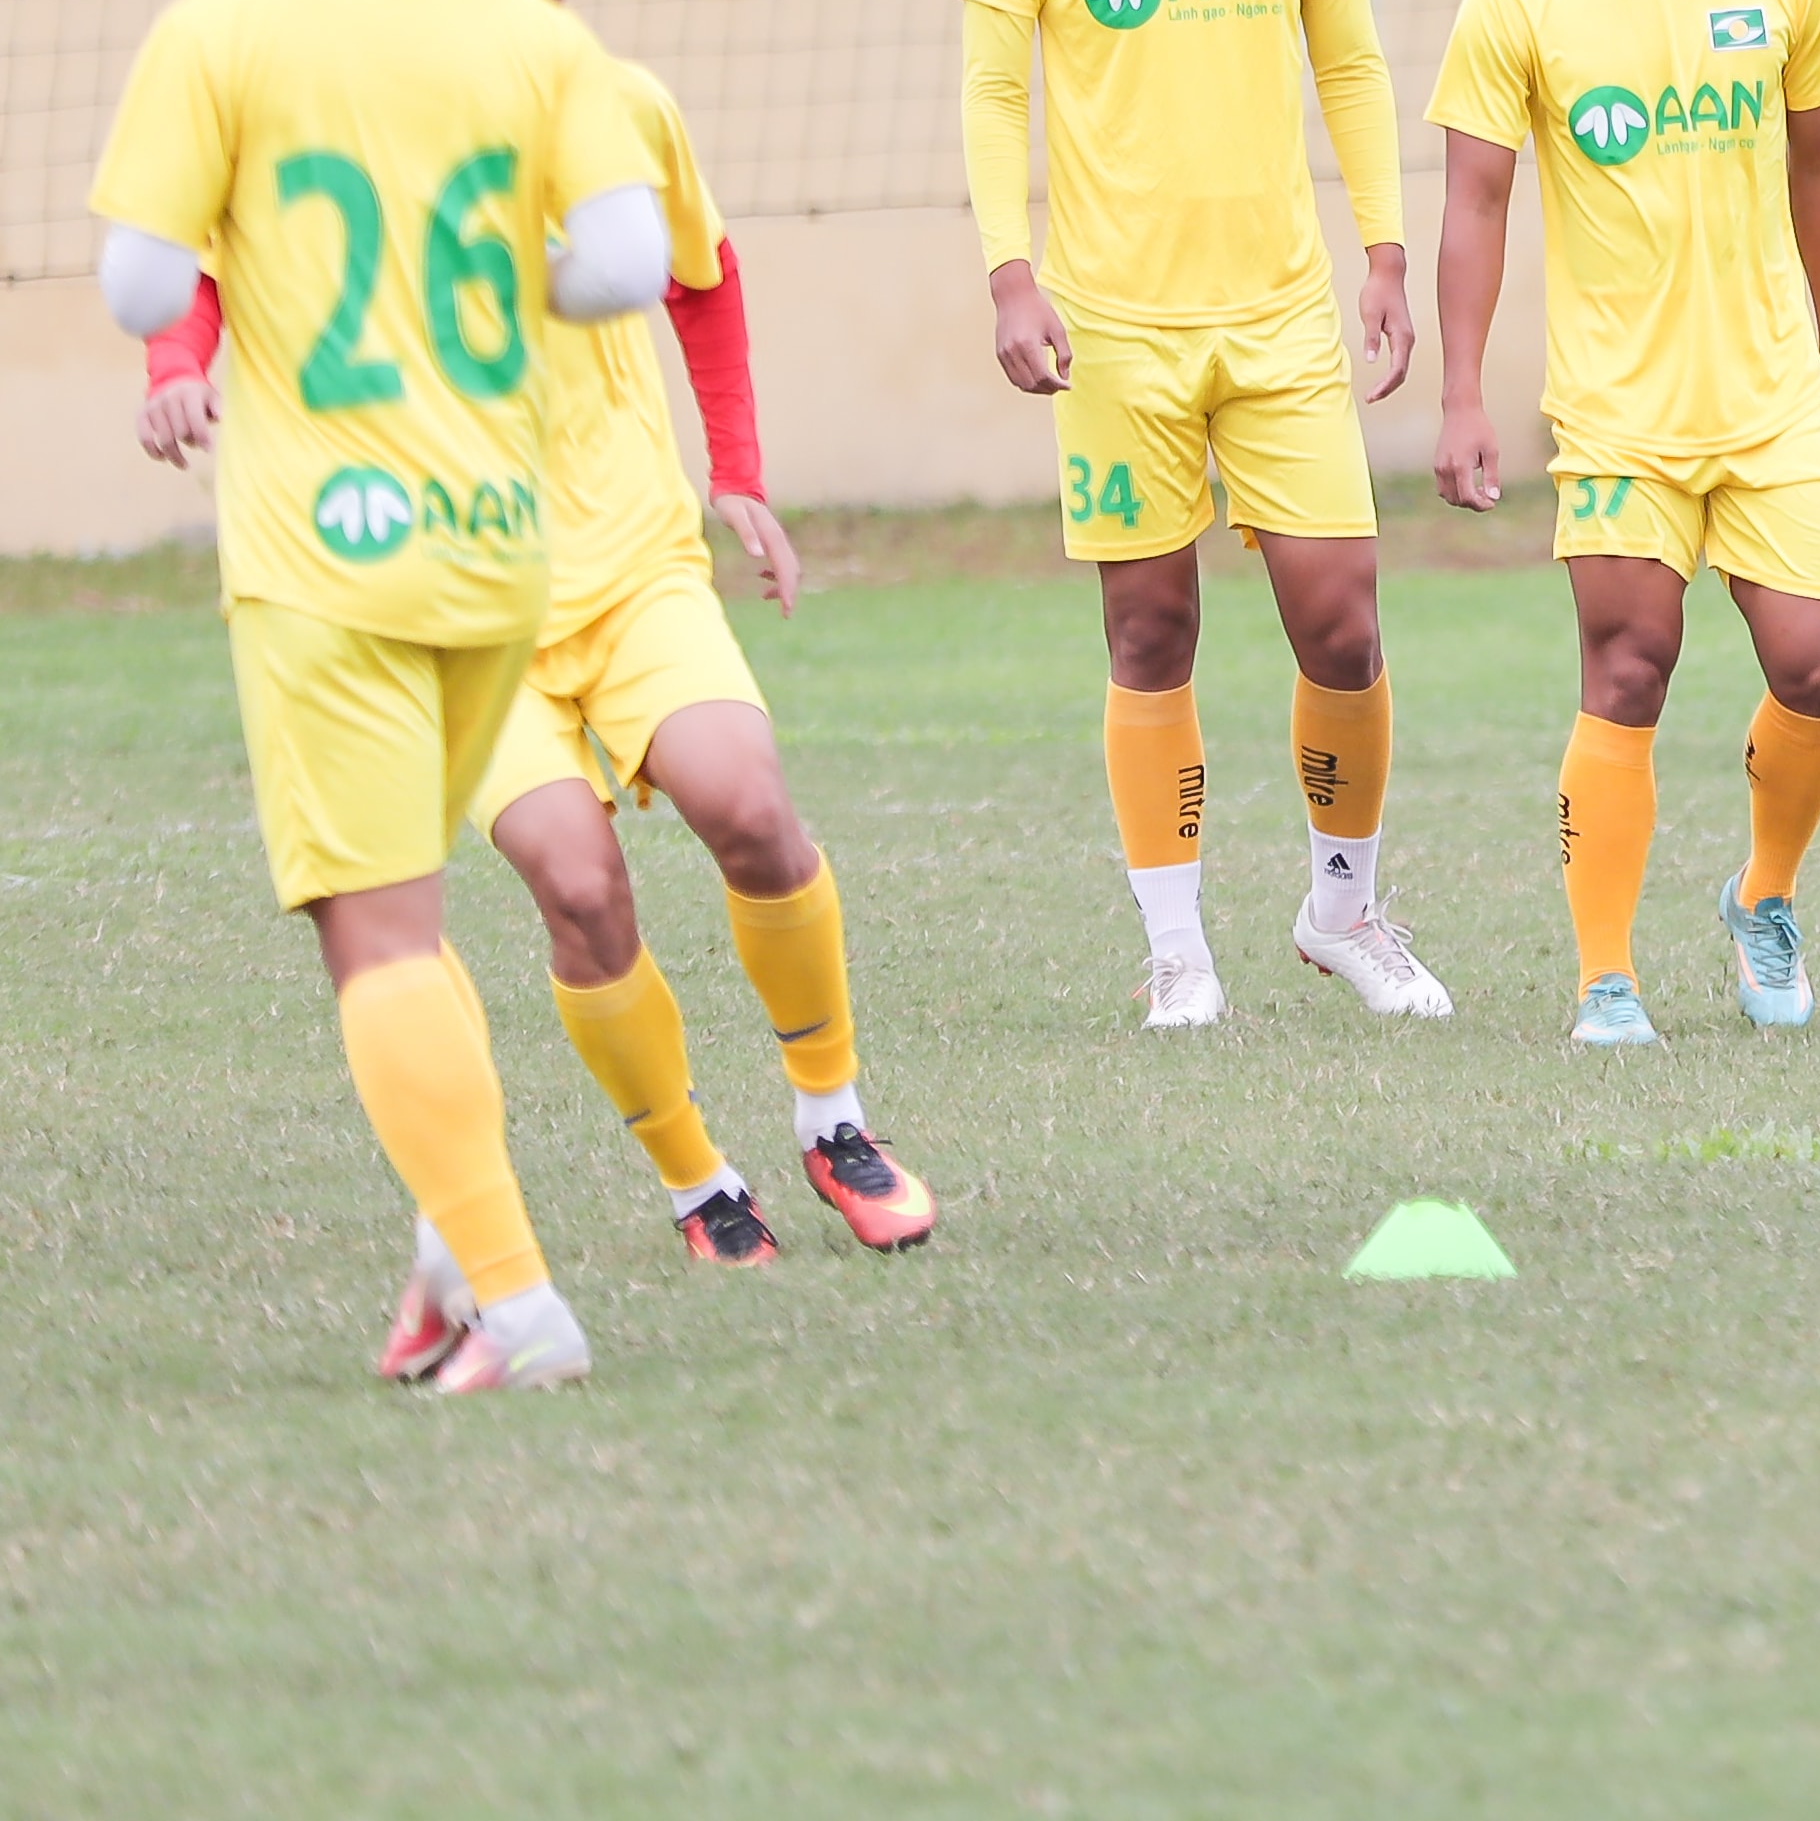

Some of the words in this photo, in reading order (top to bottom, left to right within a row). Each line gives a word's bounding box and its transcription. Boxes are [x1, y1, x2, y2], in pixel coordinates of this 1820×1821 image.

[1655, 80, 1763, 135] AAN
[274, 146, 526, 412] 26
[423, 477, 540, 536] AAN
[1068, 455, 1144, 529] 34
[1178, 764, 1205, 839] mitre
[1301, 745, 1349, 807] mitre
